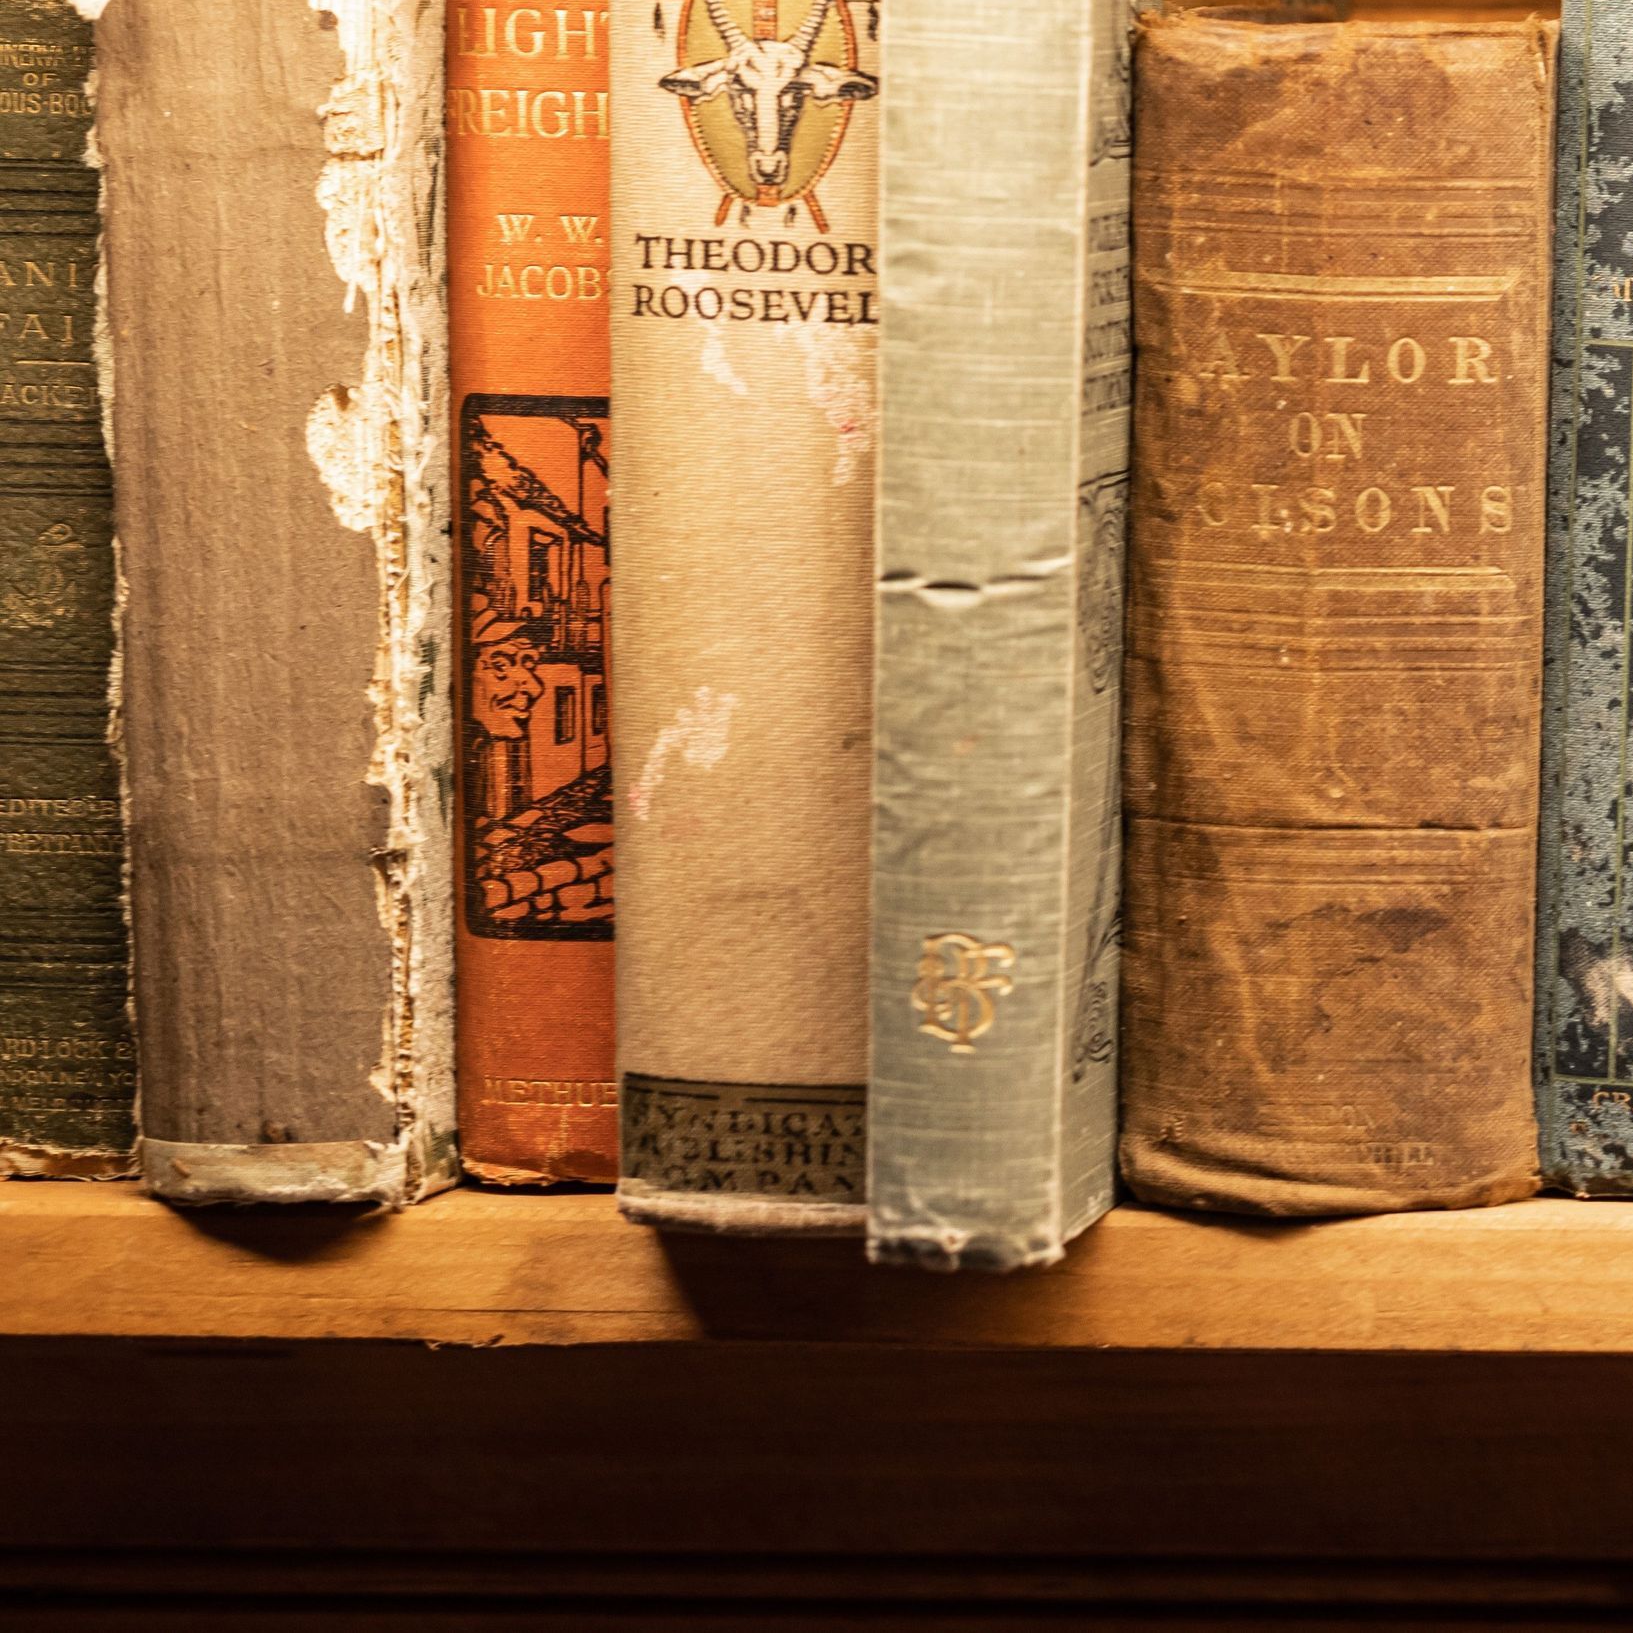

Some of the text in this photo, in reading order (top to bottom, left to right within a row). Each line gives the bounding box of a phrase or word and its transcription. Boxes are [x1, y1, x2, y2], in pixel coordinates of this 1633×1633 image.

[457, 7, 609, 60] LIGH
[22, 72, 59, 87] OF
[497, 215, 604, 245] W. W.
[635, 233, 877, 275] THEODOR
[477, 263, 610, 300] JACOB
[632, 285, 879, 325] ROOSEVEL
[1200, 333, 1500, 384] AYLOR
[1288, 412, 1367, 460] ON
